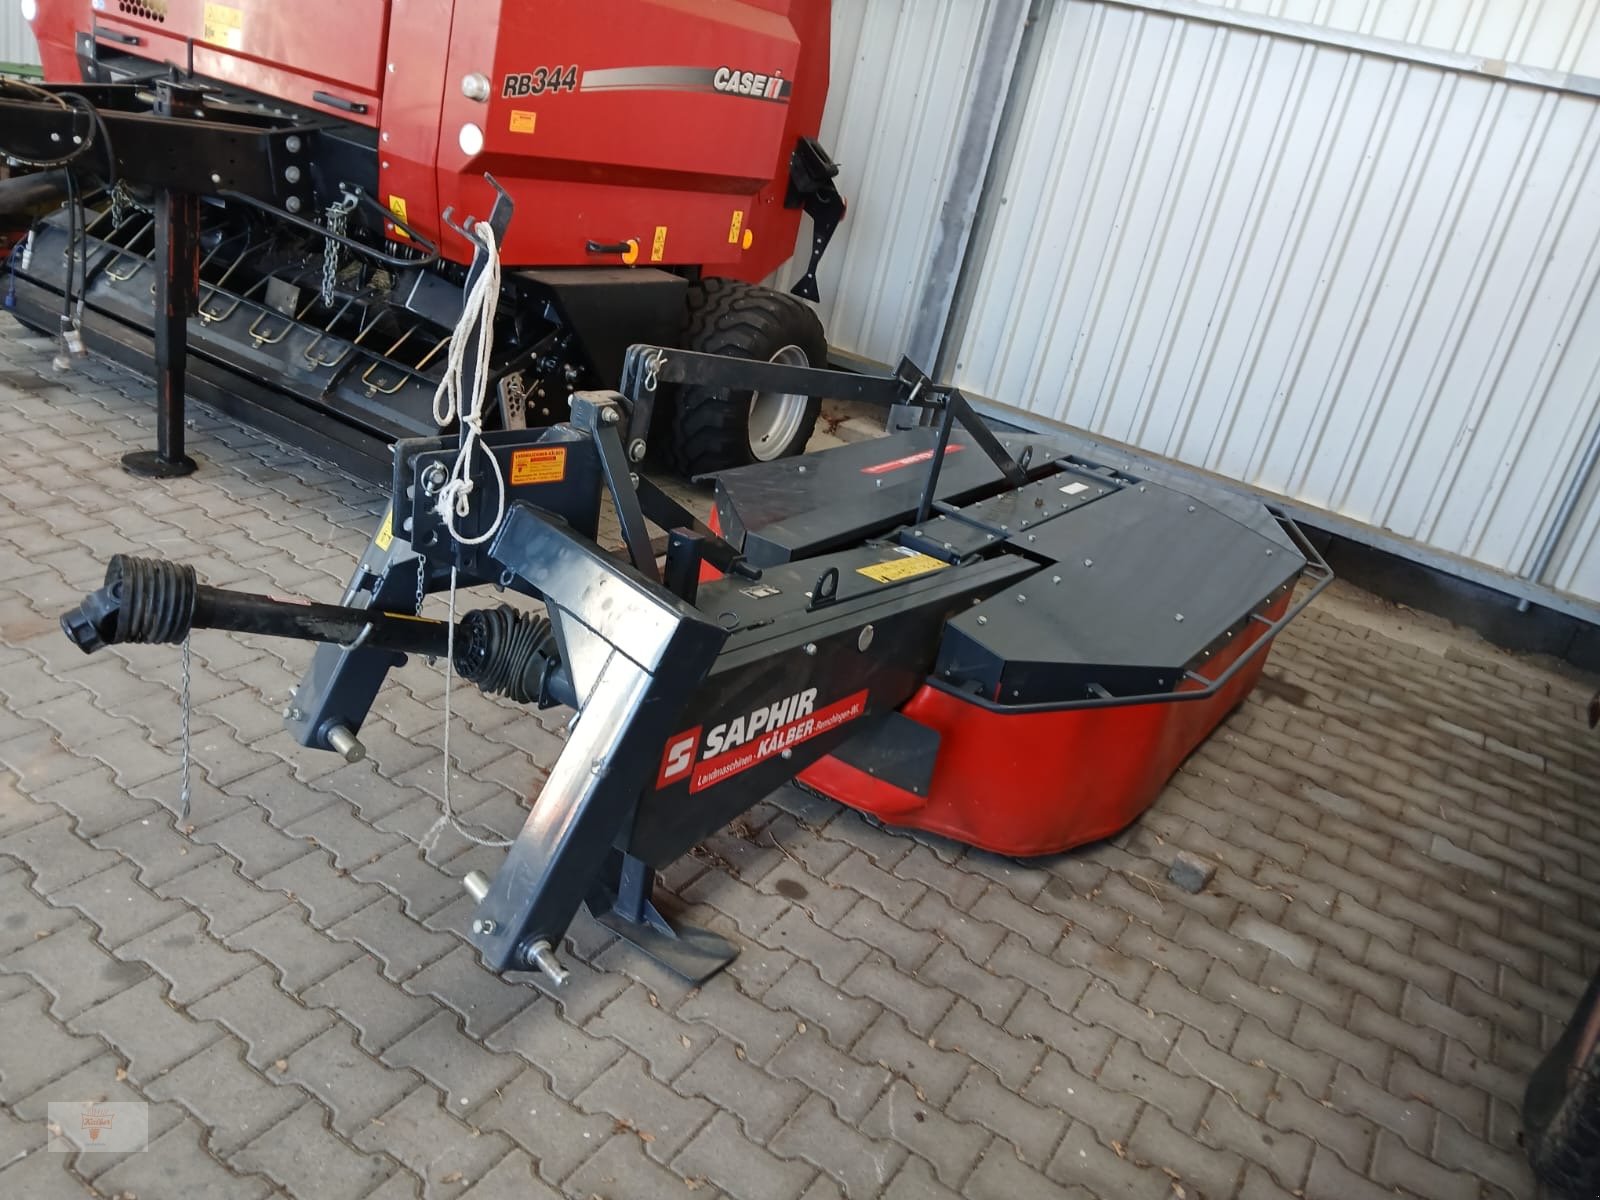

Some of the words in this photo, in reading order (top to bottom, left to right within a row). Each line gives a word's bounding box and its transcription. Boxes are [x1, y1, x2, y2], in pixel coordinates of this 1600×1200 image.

[503, 65, 577, 98] RB344
[713, 66, 768, 97] CASE
[702, 687, 818, 760] SAPHIR
[698, 754, 753, 786] Landmaschinen
[757, 718, 815, 759] KÄLBER
